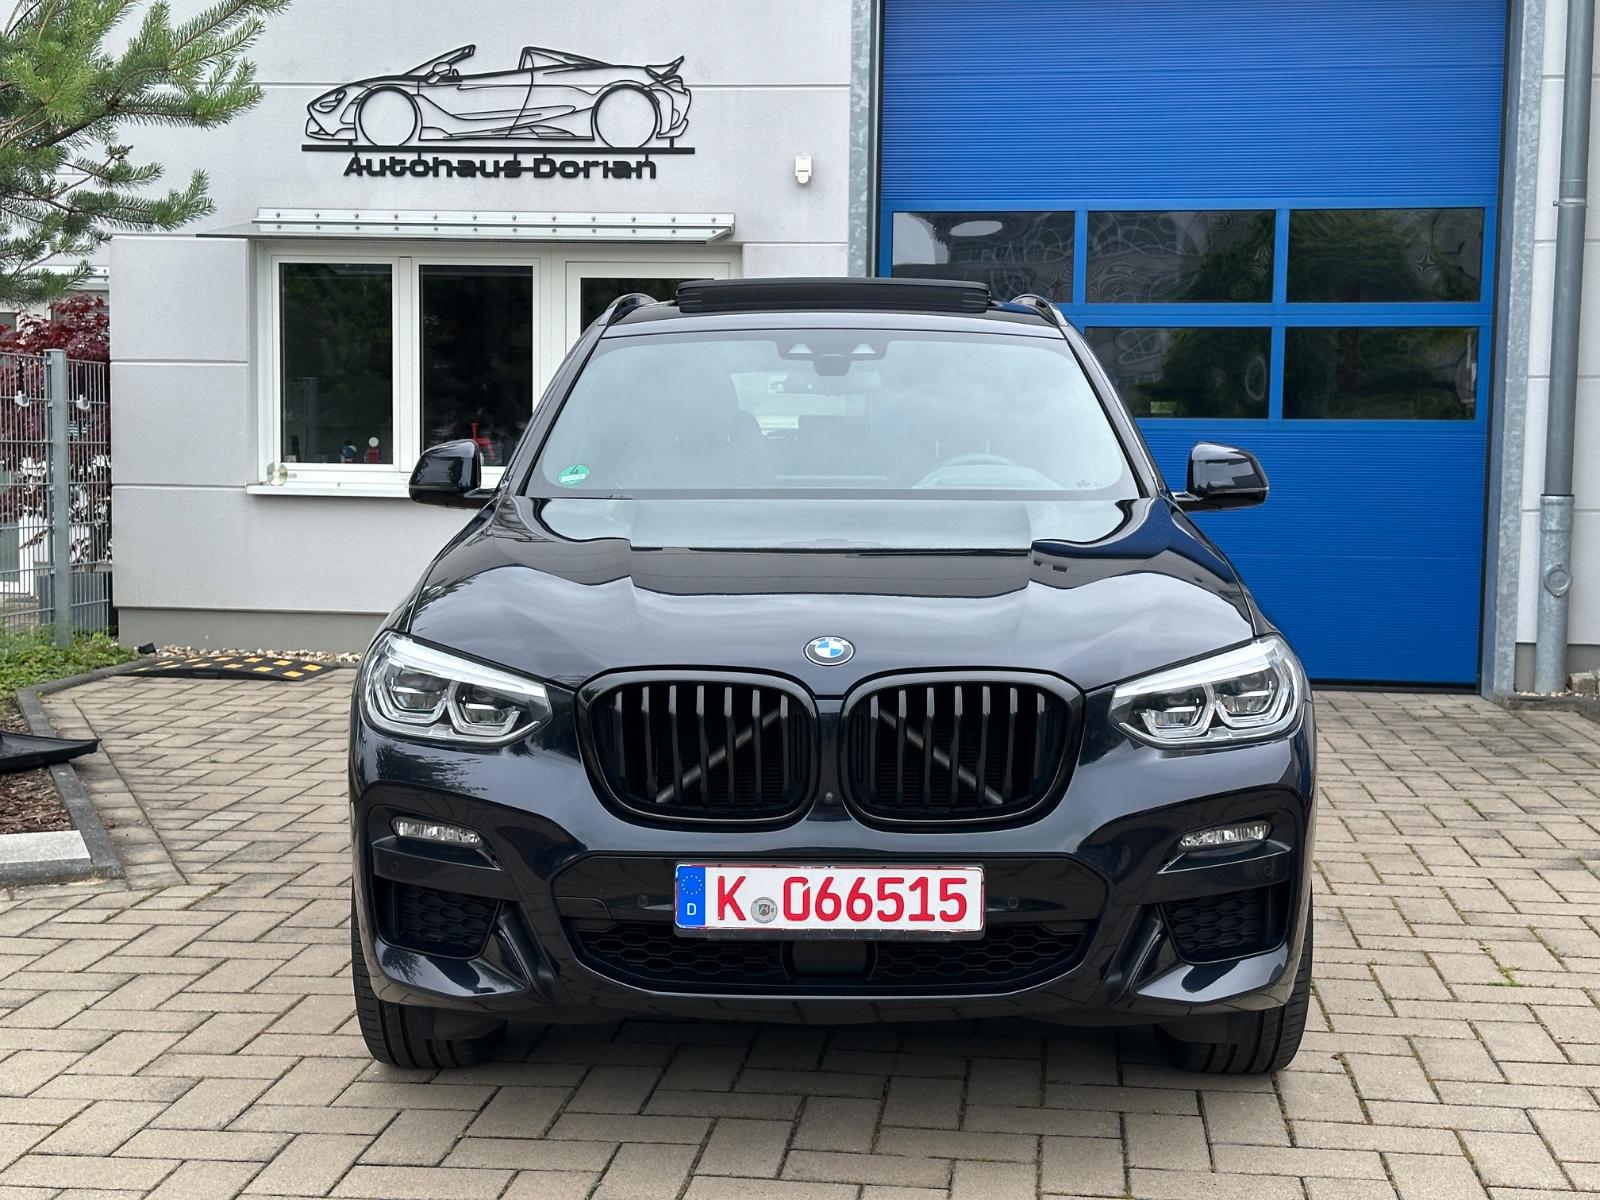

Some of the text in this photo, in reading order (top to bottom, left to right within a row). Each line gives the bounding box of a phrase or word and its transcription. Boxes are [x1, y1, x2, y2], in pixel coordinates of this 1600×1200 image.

[343, 156, 657, 180] Autohaus Dorian
[569, 465, 579, 475] 4
[716, 875, 968, 923] K 066515
[686, 902, 697, 916] D
